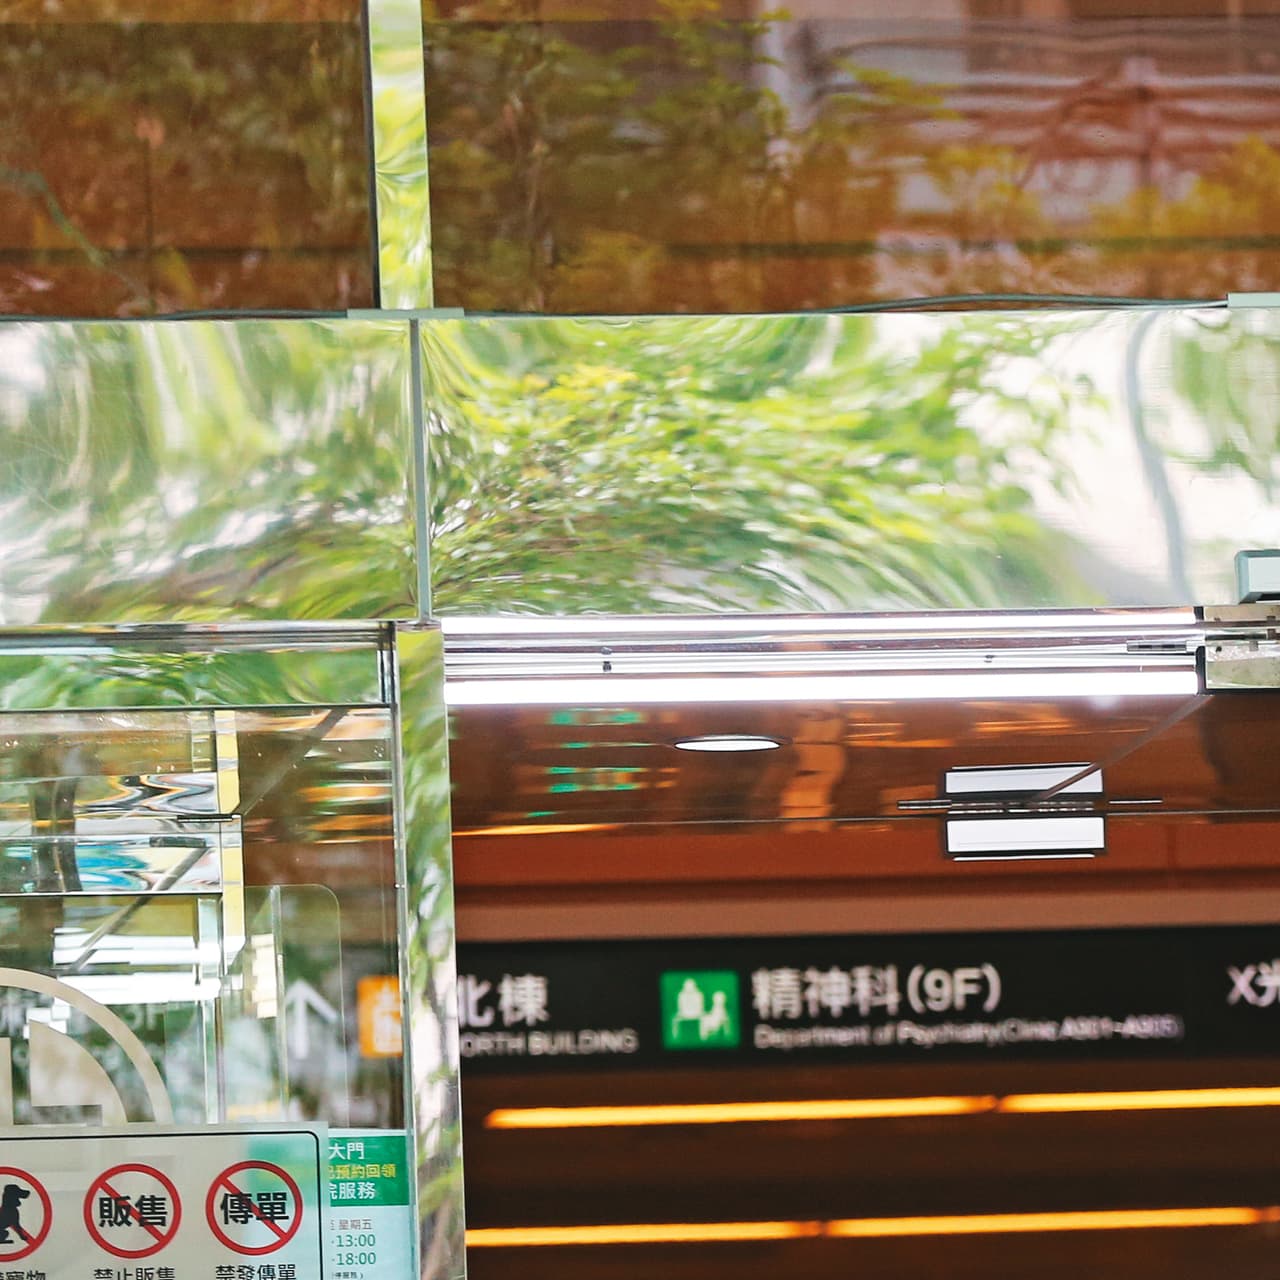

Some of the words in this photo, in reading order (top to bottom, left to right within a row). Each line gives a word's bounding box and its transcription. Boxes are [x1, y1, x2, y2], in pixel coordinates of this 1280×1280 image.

[457, 973, 550, 1027] 北棟
[752, 964, 1002, 1019] 精神科(9F)
[458, 1031, 526, 1058] ORTH
[528, 1028, 640, 1056] BUILDING
[328, 1142, 365, 1160] 大門
[98, 1194, 167, 1229] 販售
[220, 1191, 290, 1227] 傳單
